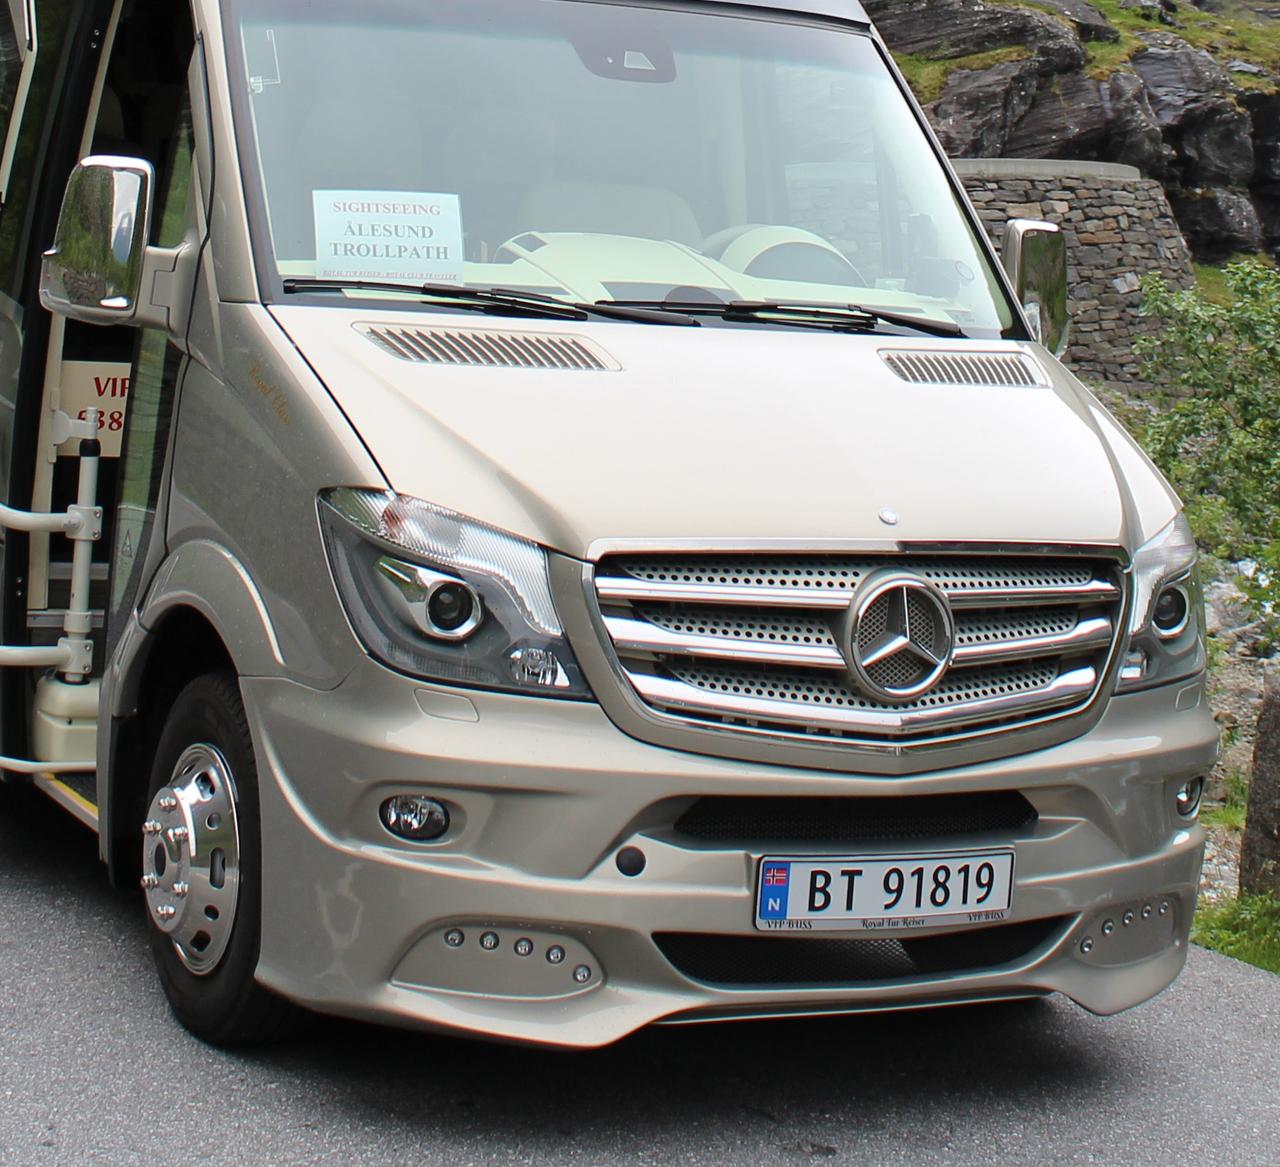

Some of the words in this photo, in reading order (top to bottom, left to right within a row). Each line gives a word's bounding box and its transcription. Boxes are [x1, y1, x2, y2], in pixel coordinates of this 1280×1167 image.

[333, 202, 440, 215] SIGHTSEEING
[343, 220, 434, 239] ÅLESUND
[329, 242, 449, 260] TROLLPATH
[808, 870, 863, 912] BT
[882, 861, 995, 910] 91819
[767, 898, 781, 911] N
